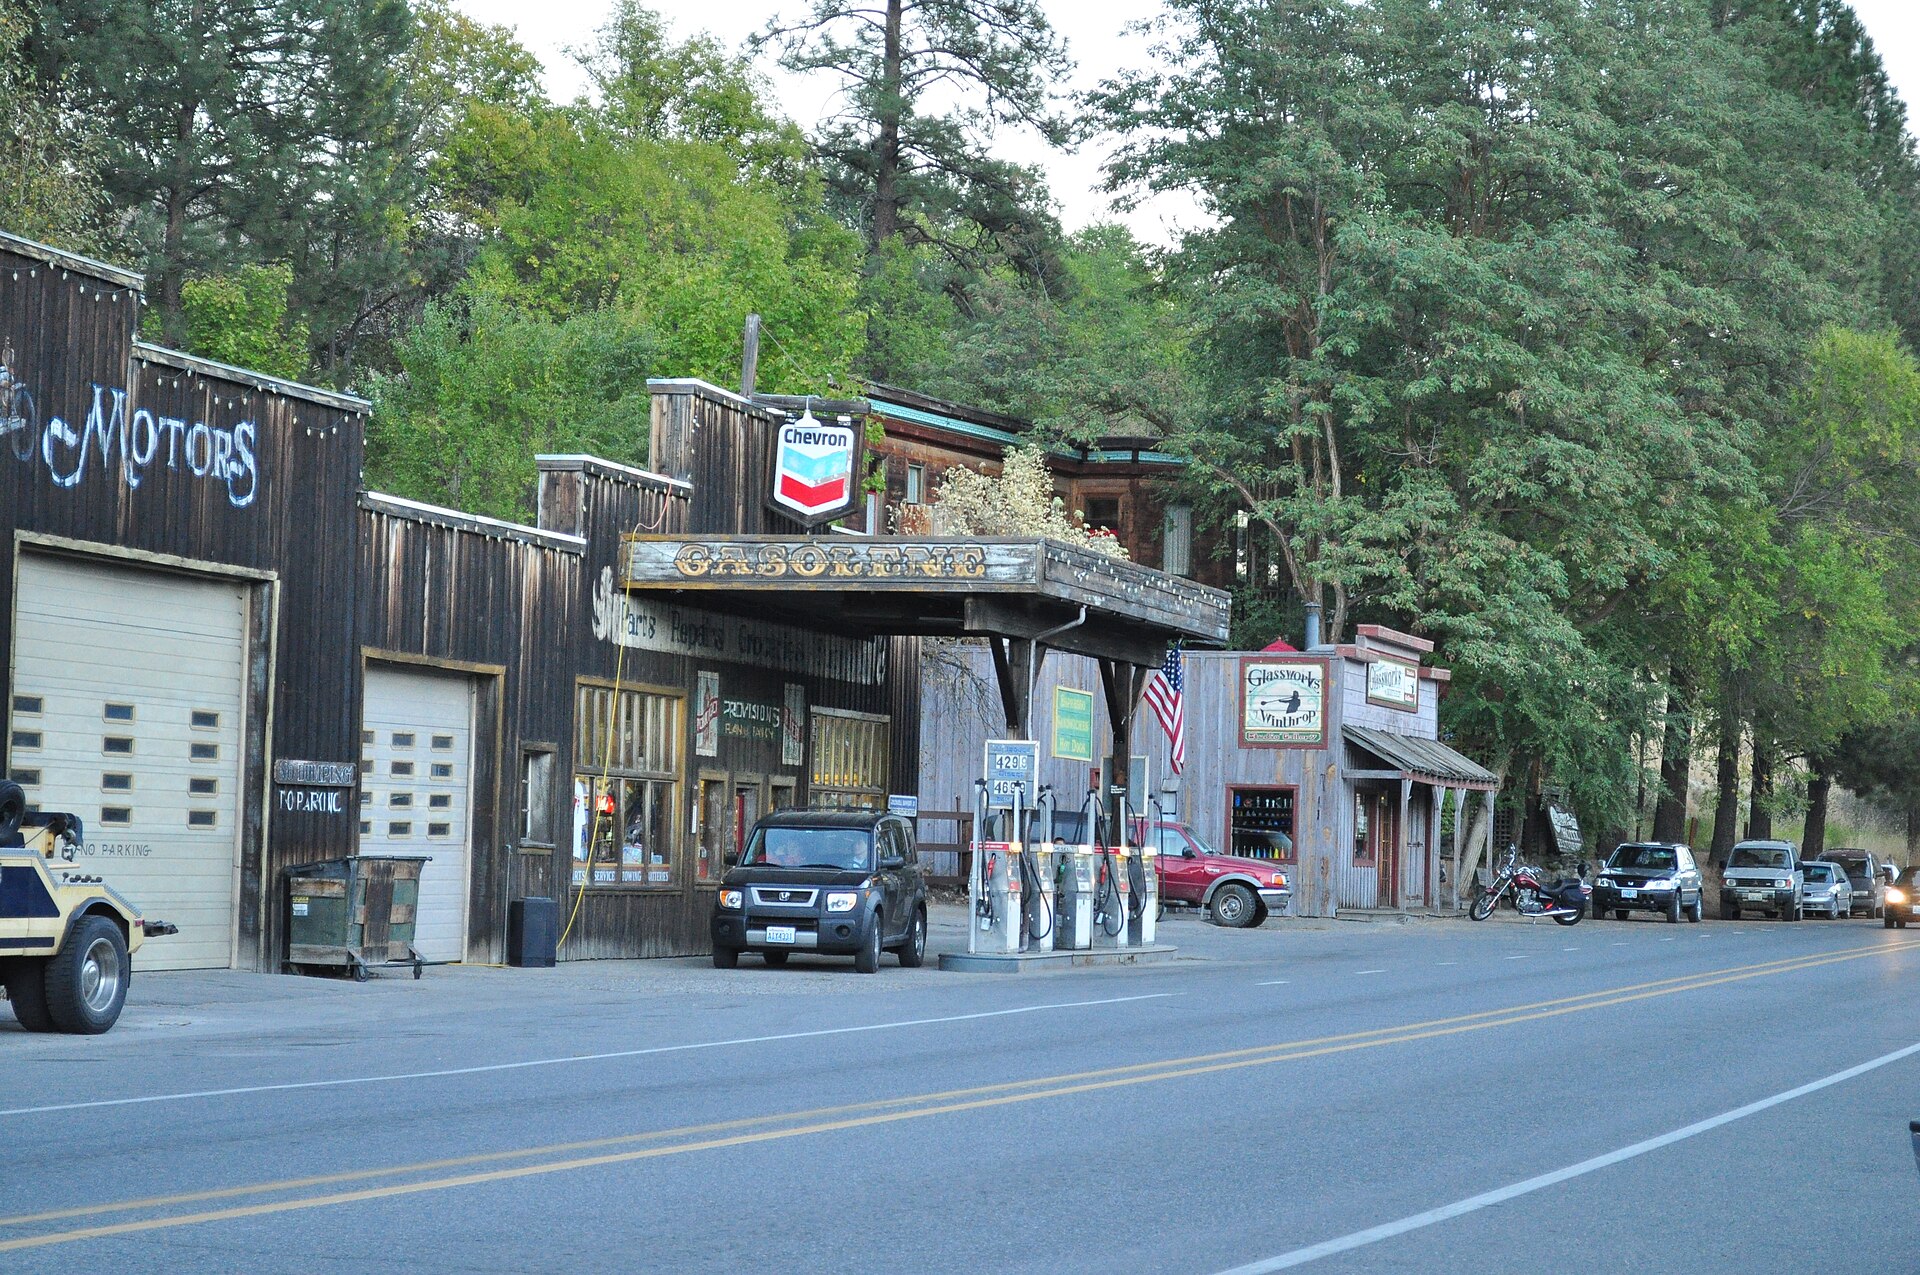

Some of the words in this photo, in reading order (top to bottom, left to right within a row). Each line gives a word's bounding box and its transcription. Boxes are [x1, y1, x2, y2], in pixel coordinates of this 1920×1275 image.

[784, 428, 847, 446] Chevron
[674, 543, 986, 577] GASOLENE
[621, 601, 656, 640] Parts
[670, 610, 725, 652] Repairs
[1247, 668, 1320, 689] Glassworks
[723, 700, 781, 727] PROVISIONS
[1259, 708, 1316, 728] Winthrop
[78, 843, 96, 856] NO
[101, 844, 152, 857] PARKING
[594, 870, 616, 882] SERVICE
